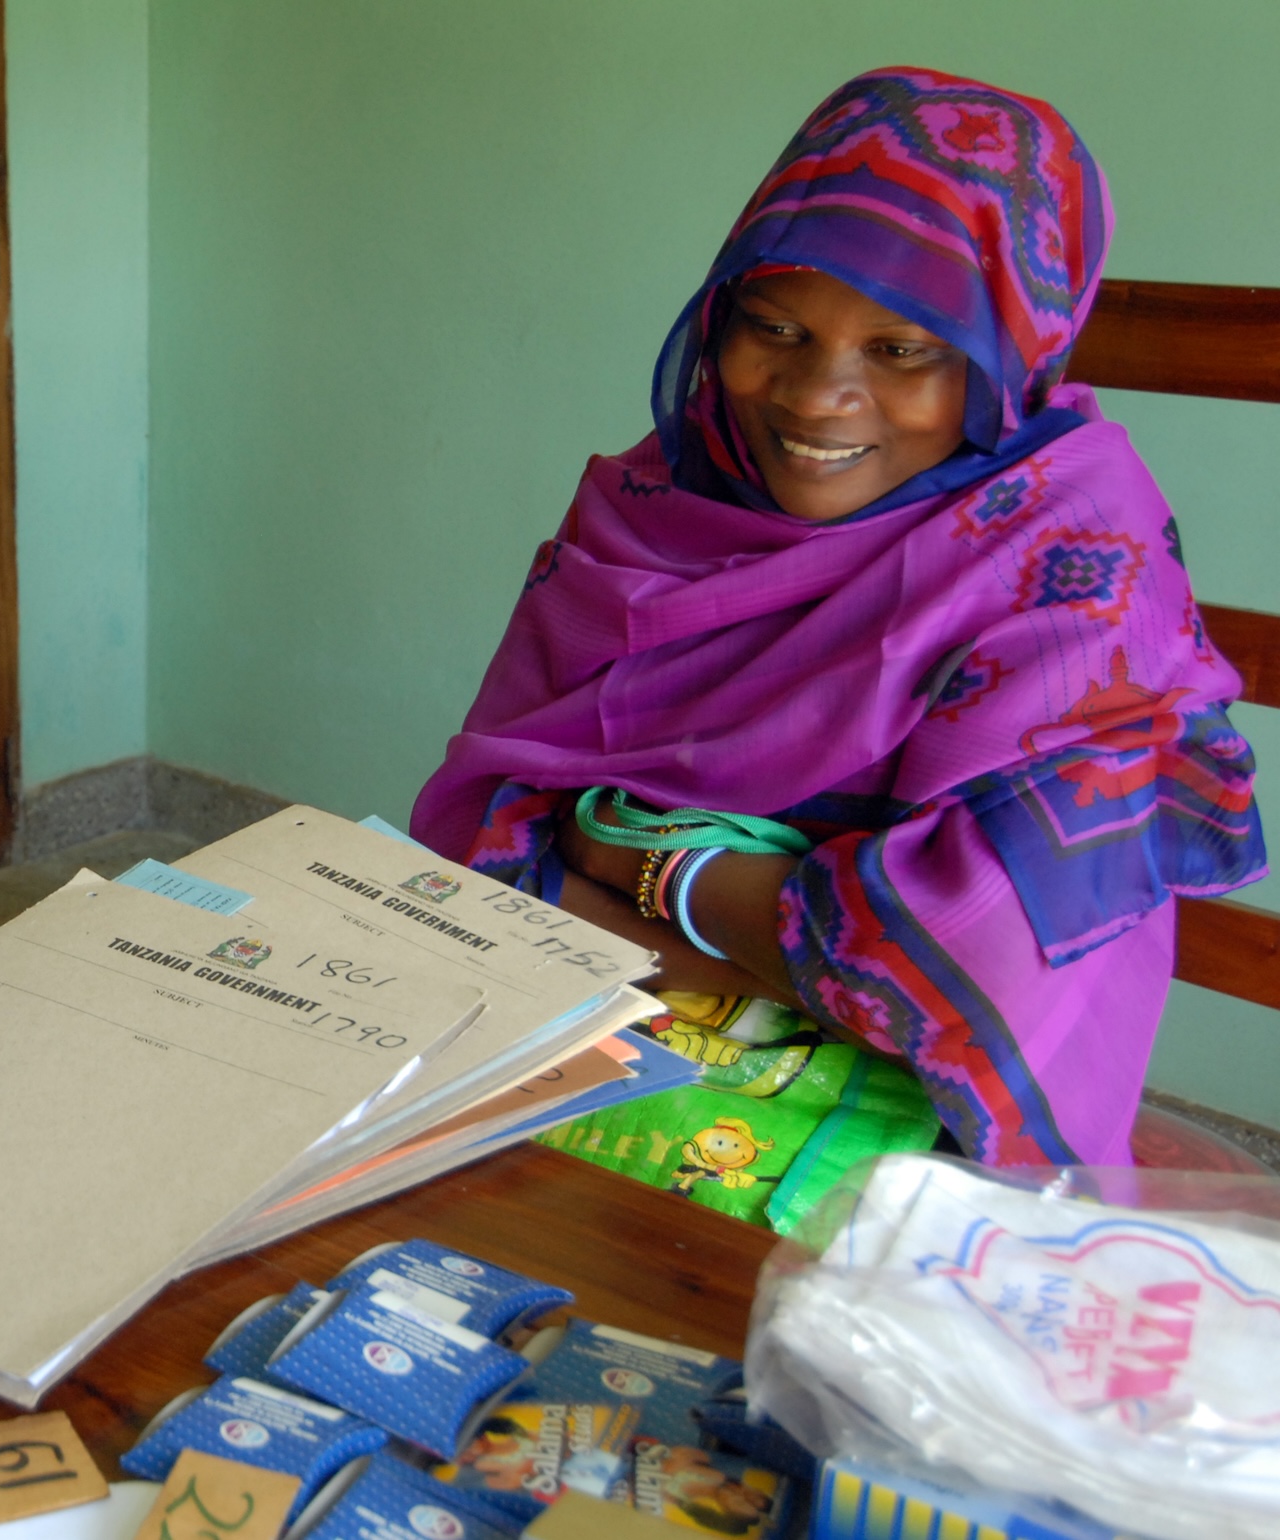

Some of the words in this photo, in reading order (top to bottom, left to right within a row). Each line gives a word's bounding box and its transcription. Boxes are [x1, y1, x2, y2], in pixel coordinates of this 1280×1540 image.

[306, 861, 383, 900] TANZANIA
[381, 896, 498, 953] GOVERNMENT
[340, 912, 387, 938] SUBJECT
[481, 890, 574, 930] 1861
[108, 937, 193, 973] TANZANIA
[192, 966, 323, 1014] GOVERNMENT
[296, 953, 398, 989] 1861
[531, 936, 622, 979] 1752
[153, 988, 204, 1009] SUBJECT
[132, 1034, 170, 1051] MINUTES
[311, 1012, 408, 1048] 1790
[521, 1404, 567, 1495] Salama
[633, 1440, 671, 1516] Salam
